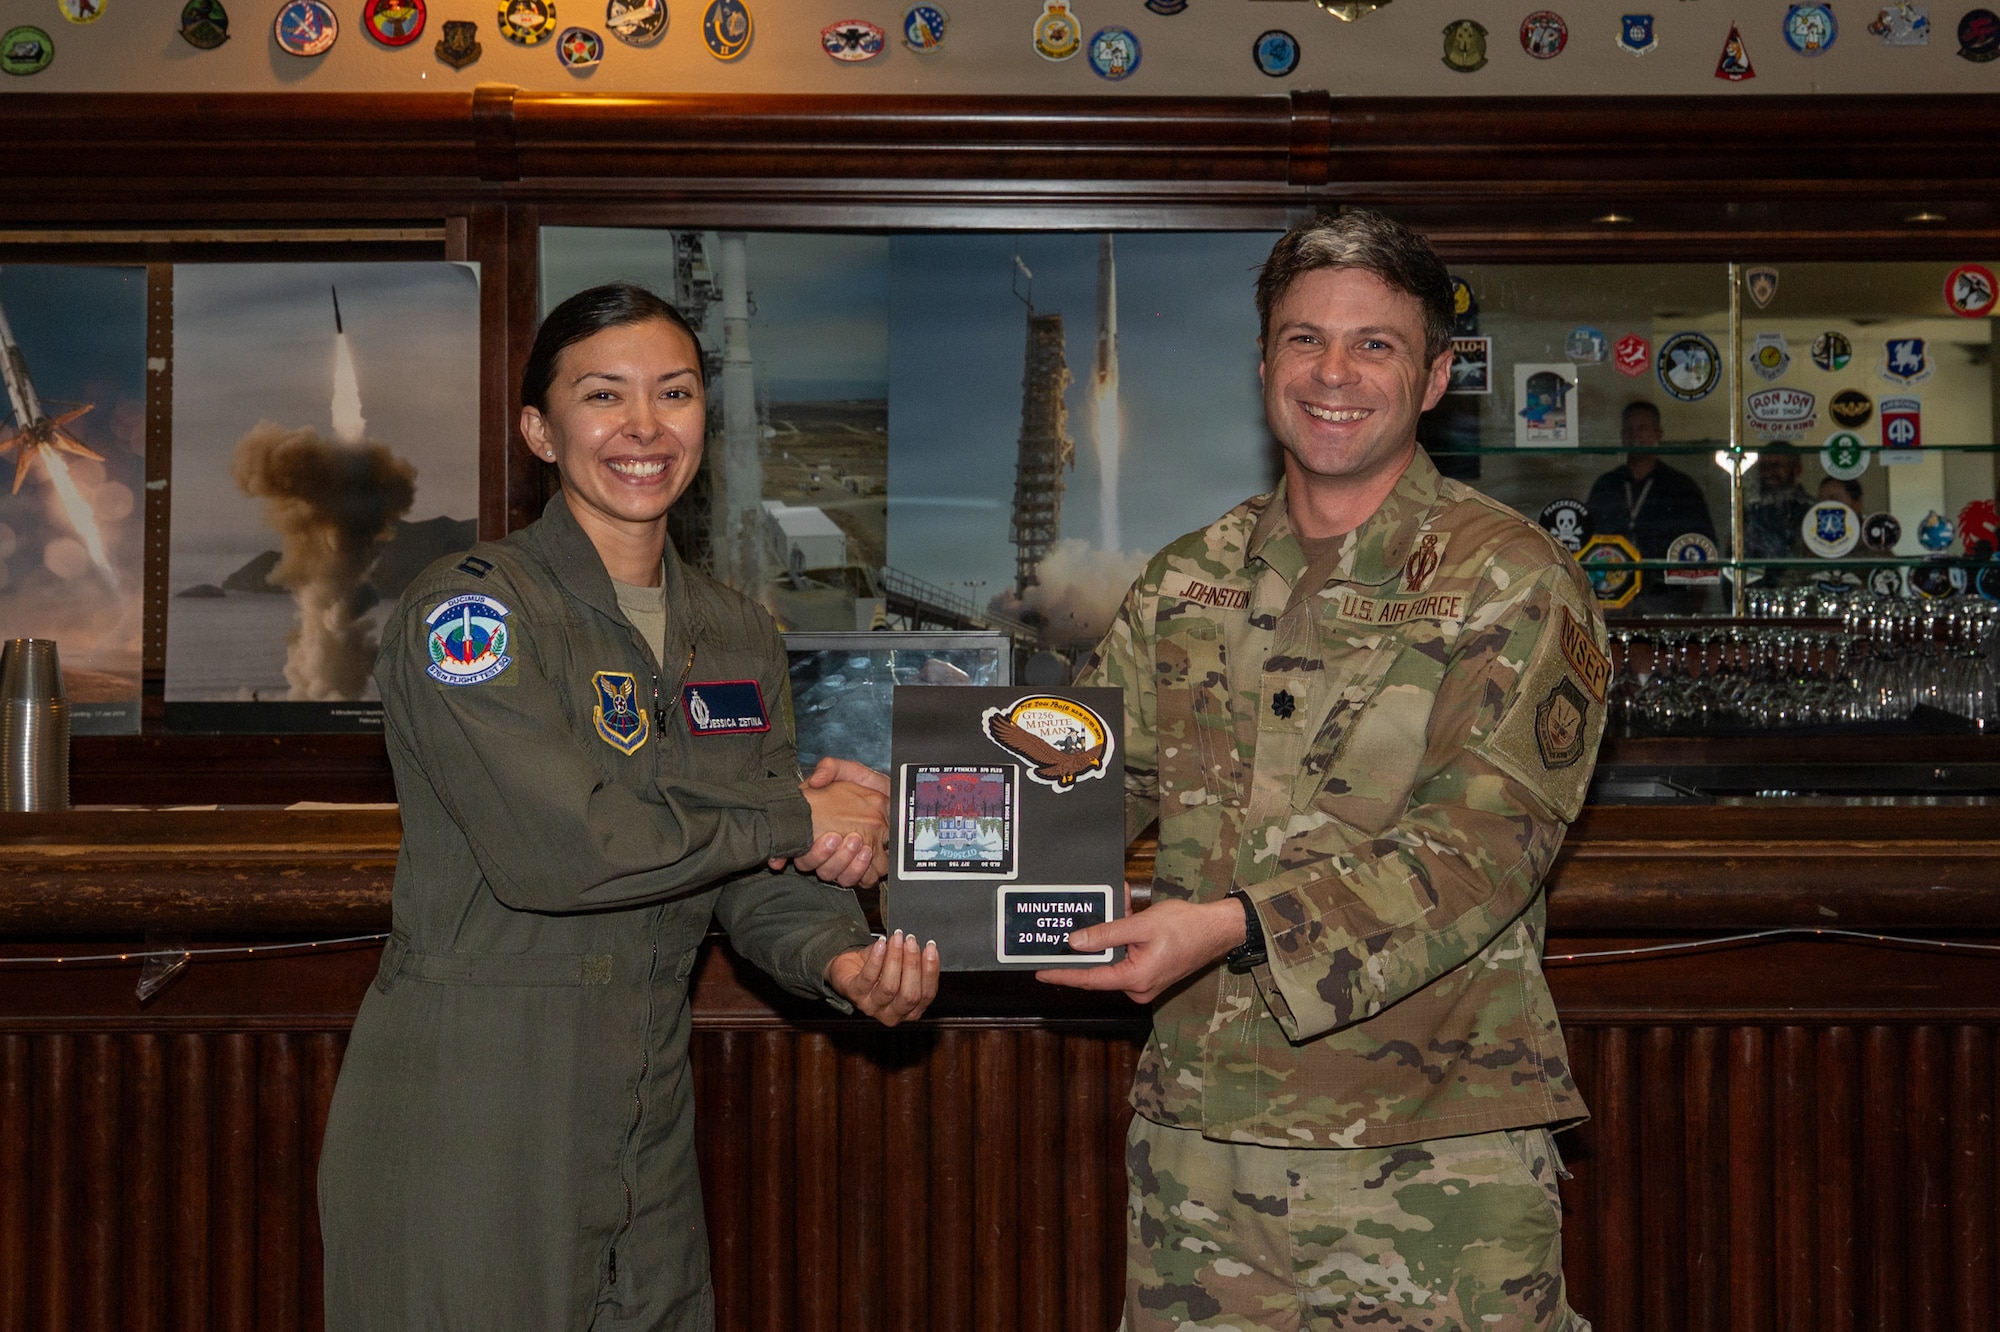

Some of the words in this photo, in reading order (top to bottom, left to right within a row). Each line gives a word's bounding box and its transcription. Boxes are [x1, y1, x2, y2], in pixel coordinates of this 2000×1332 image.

[1754, 392, 1780, 410] RON
[1783, 393, 1810, 408] JON
[1750, 420, 1769, 430] ONE
[1771, 423, 1782, 431] OF
[1785, 423, 1791, 431] A
[1793, 420, 1815, 430] KIND
[1544, 500, 1588, 516] PEACEKEEPER
[1179, 580, 1252, 609] JOHNSTON
[447, 596, 486, 607] DUCIMUS
[1342, 595, 1374, 621] U.S.
[1378, 602, 1409, 622] AIR
[1407, 596, 1462, 619] FORCE
[1565, 615, 1606, 686] WSEP
[449, 674, 478, 684] FLIGHT
[479, 667, 499, 680] TEST
[499, 657, 509, 668] SQ
[1022, 711, 1054, 720] GT256
[709, 718, 737, 729] JESSICA
[738, 717, 763, 727] ZETINA
[1026, 718, 1073, 729] MINUTE
[1040, 727, 1067, 737] MAN
[1017, 902, 1093, 913] MINUTEMAN
[1036, 917, 1074, 928] GT256
[1018, 932, 1033, 943] 20
[1036, 932, 1060, 945] May
